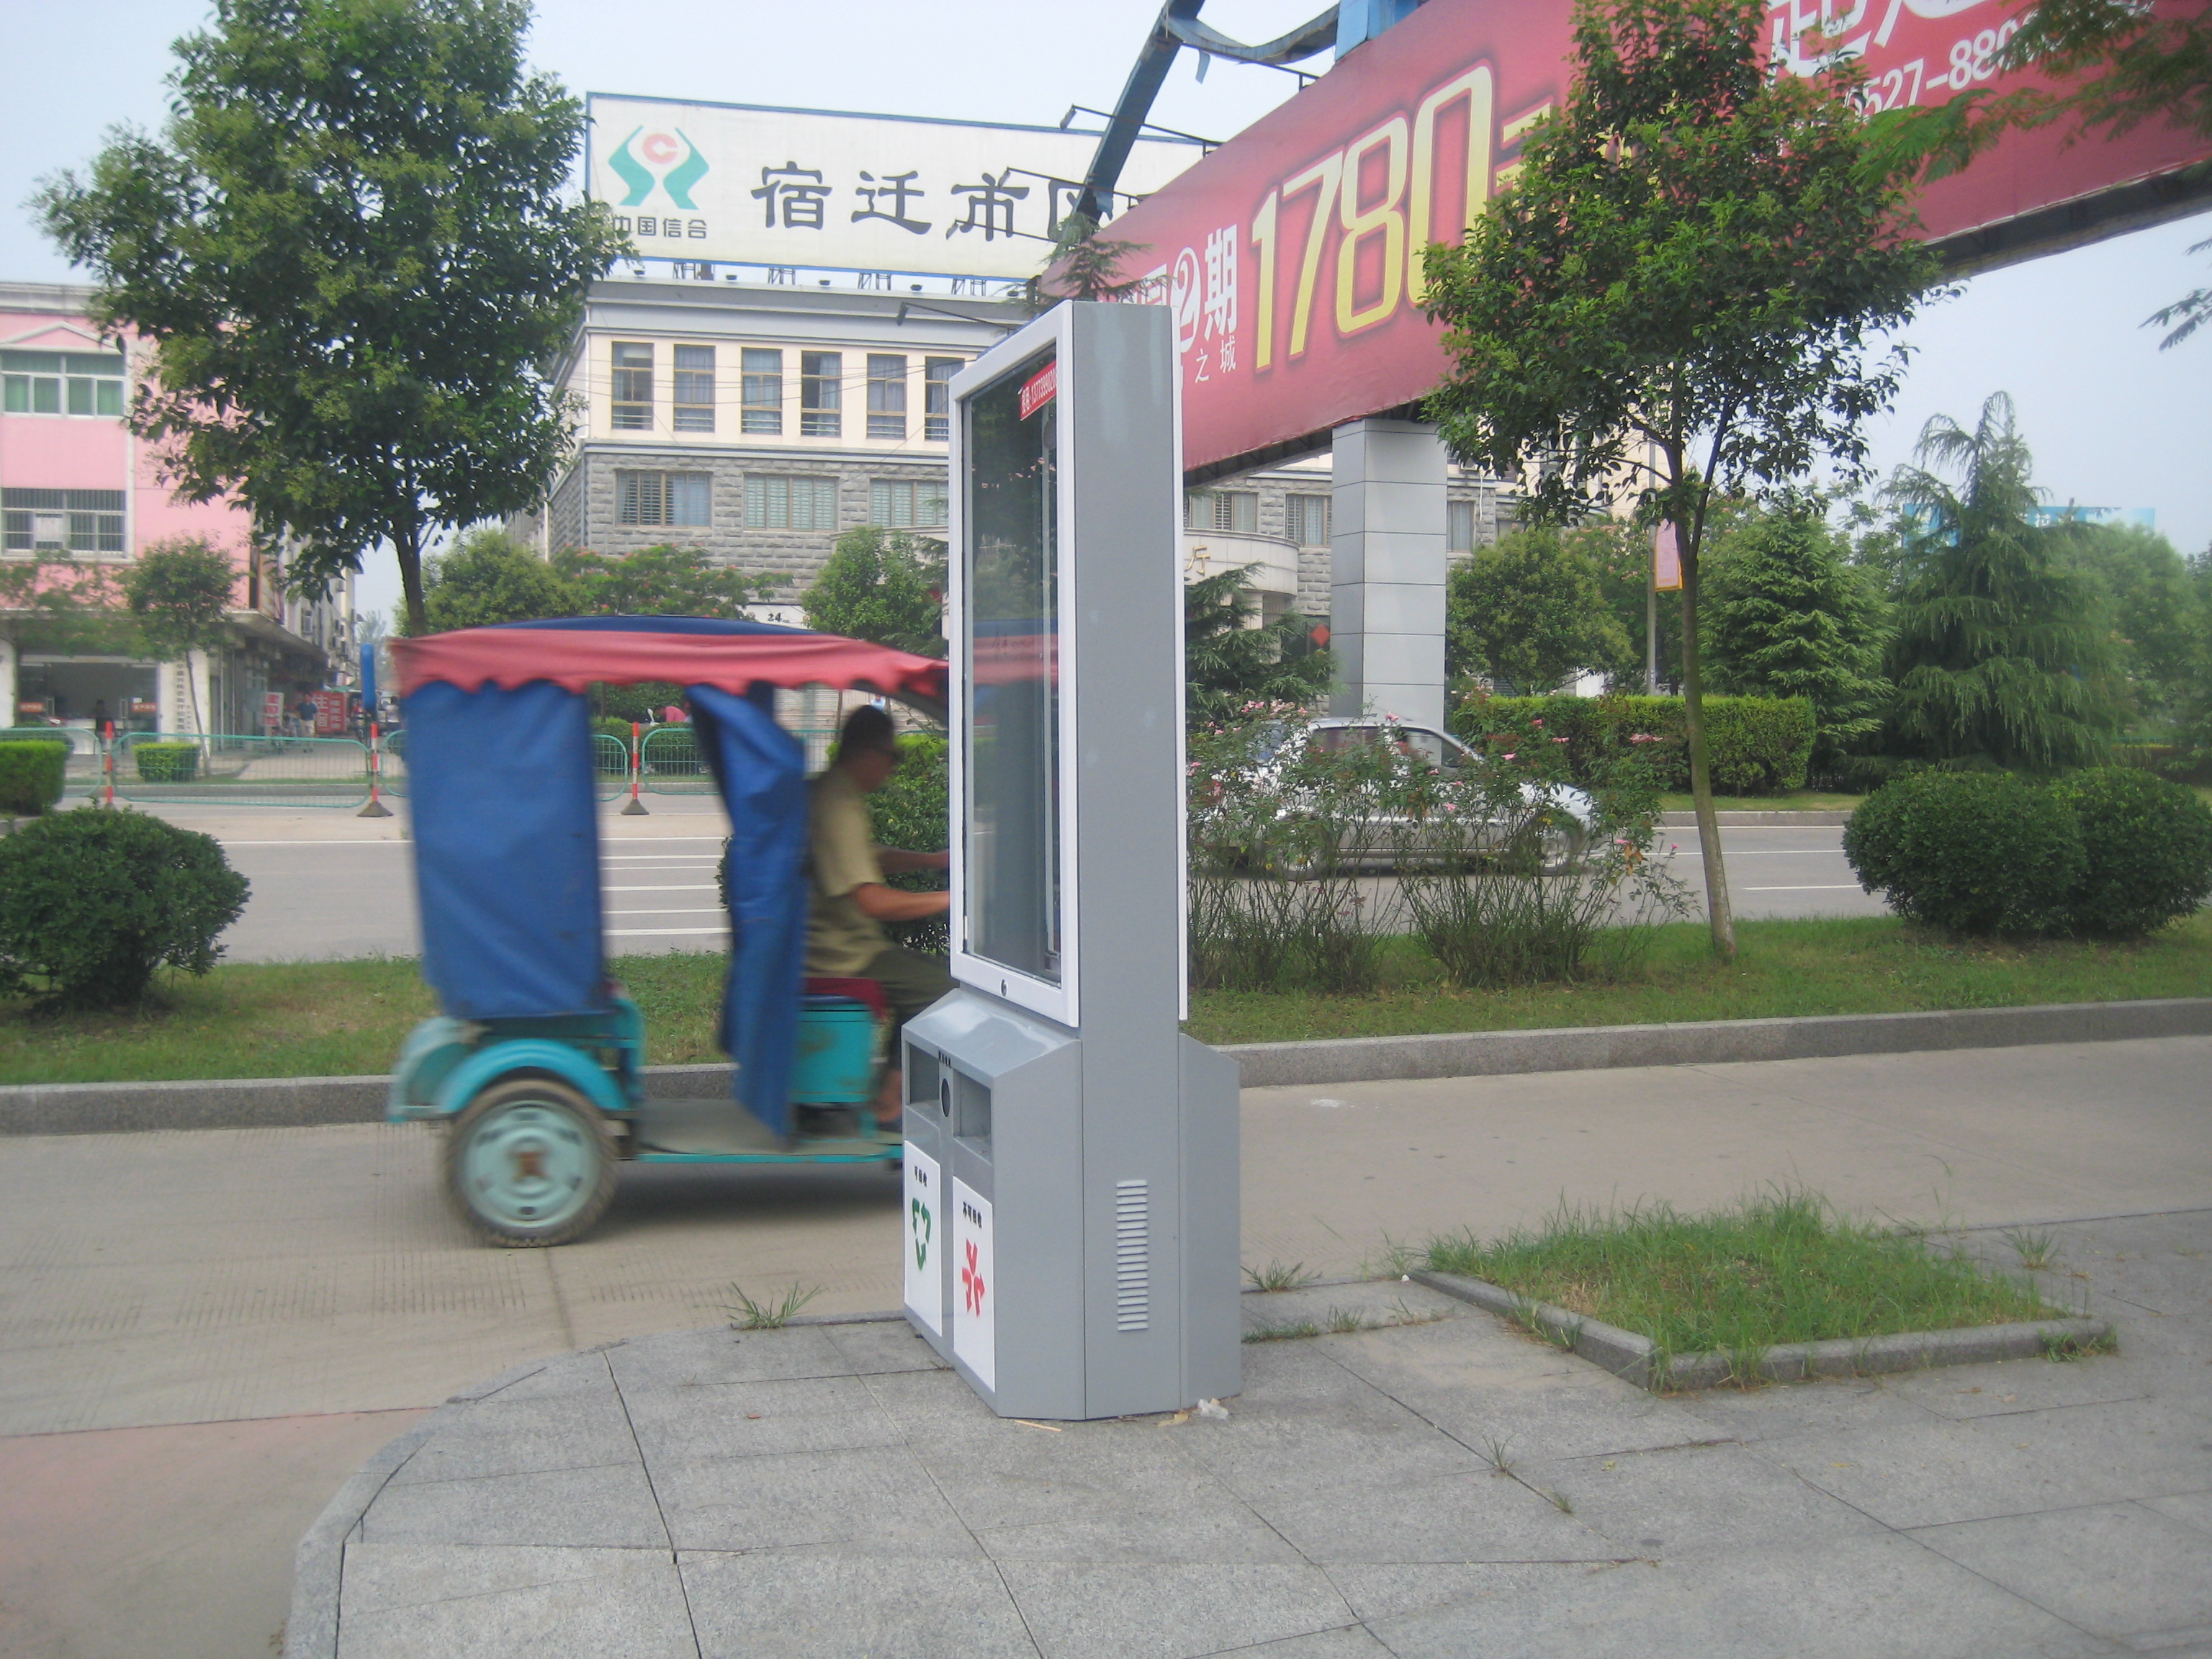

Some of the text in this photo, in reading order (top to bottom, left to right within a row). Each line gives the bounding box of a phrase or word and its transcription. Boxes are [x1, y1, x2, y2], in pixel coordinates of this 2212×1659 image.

[1252, 66, 1554, 369] 1780
[1182, 335, 1236, 390] 之城
[1185, 545, 1210, 576] 厅
